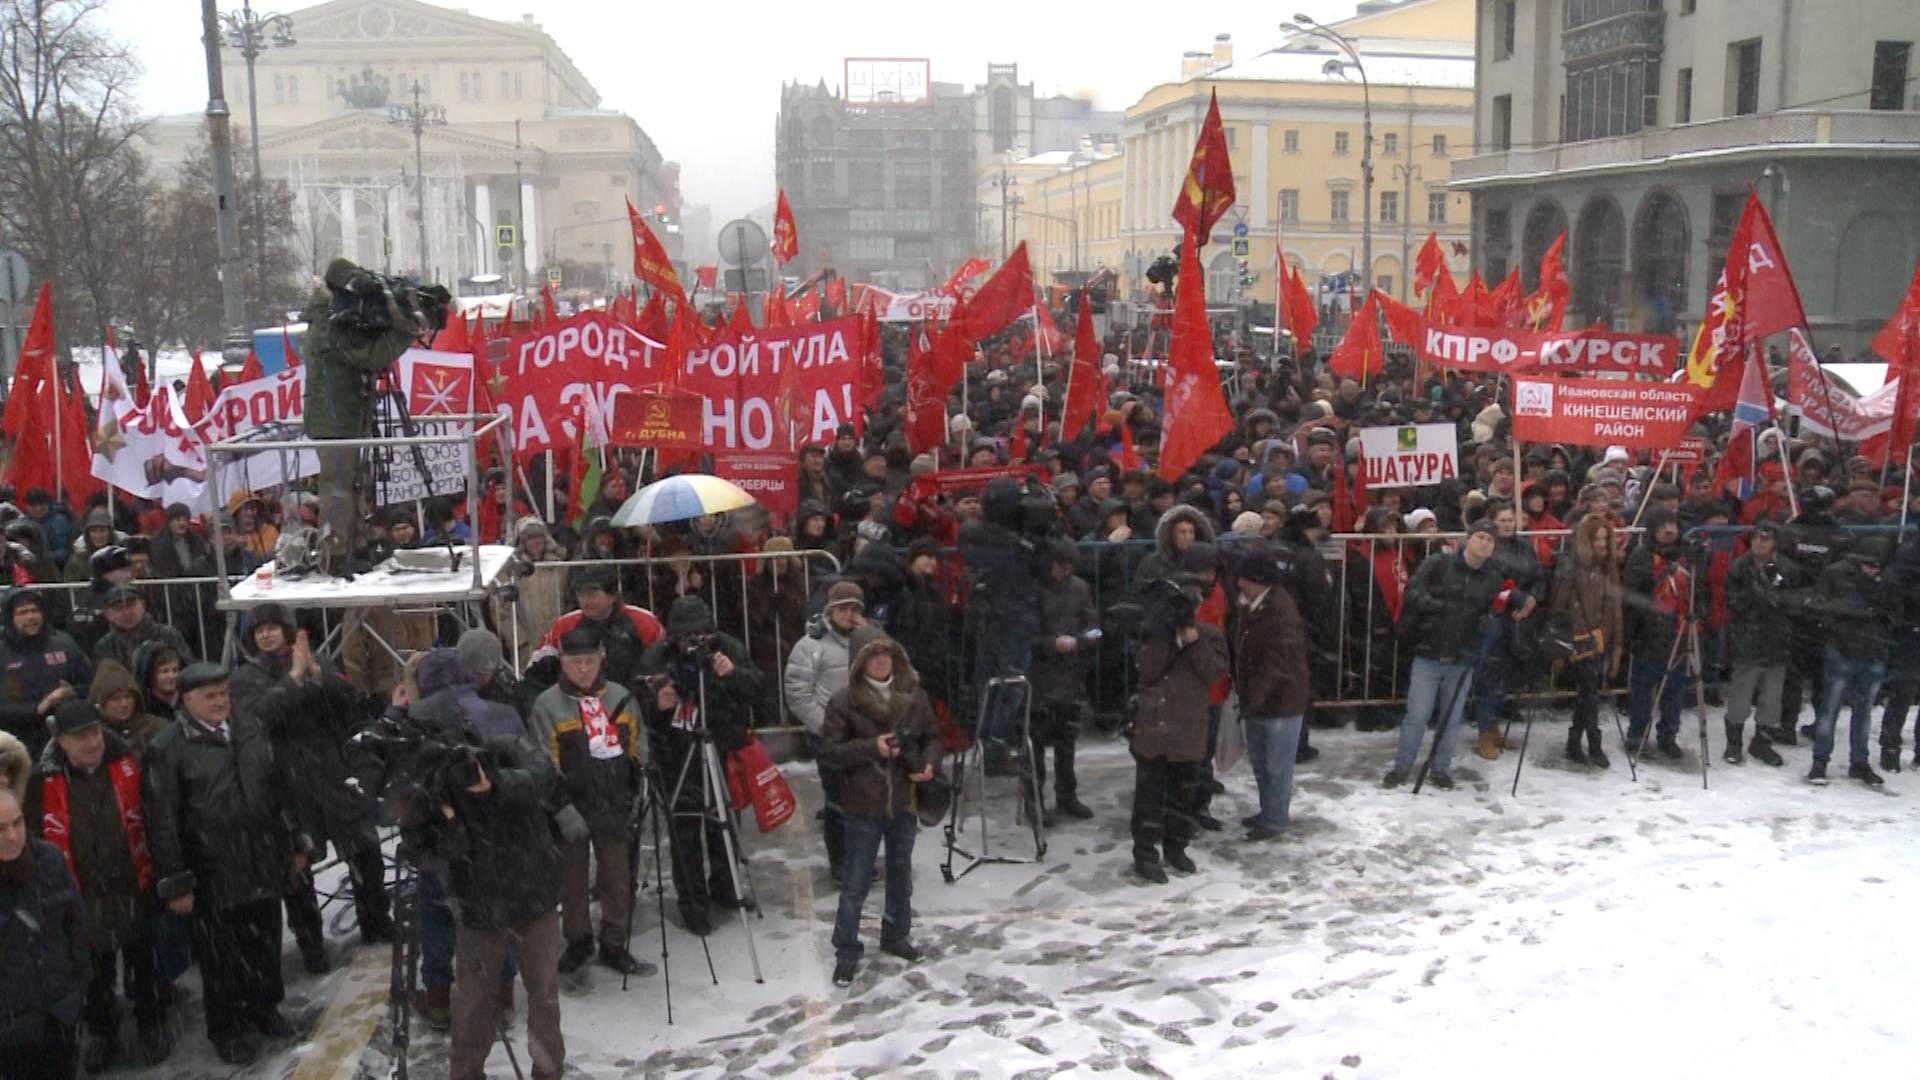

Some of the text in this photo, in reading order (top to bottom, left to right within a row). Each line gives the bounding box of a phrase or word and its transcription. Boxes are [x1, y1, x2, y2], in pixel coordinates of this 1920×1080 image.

[1563, 403, 1688, 422] КИНЕШЕМСКИЙ
[1594, 421, 1645, 437] РАЙОН
[1364, 452, 1455, 484] ШАТУРА
